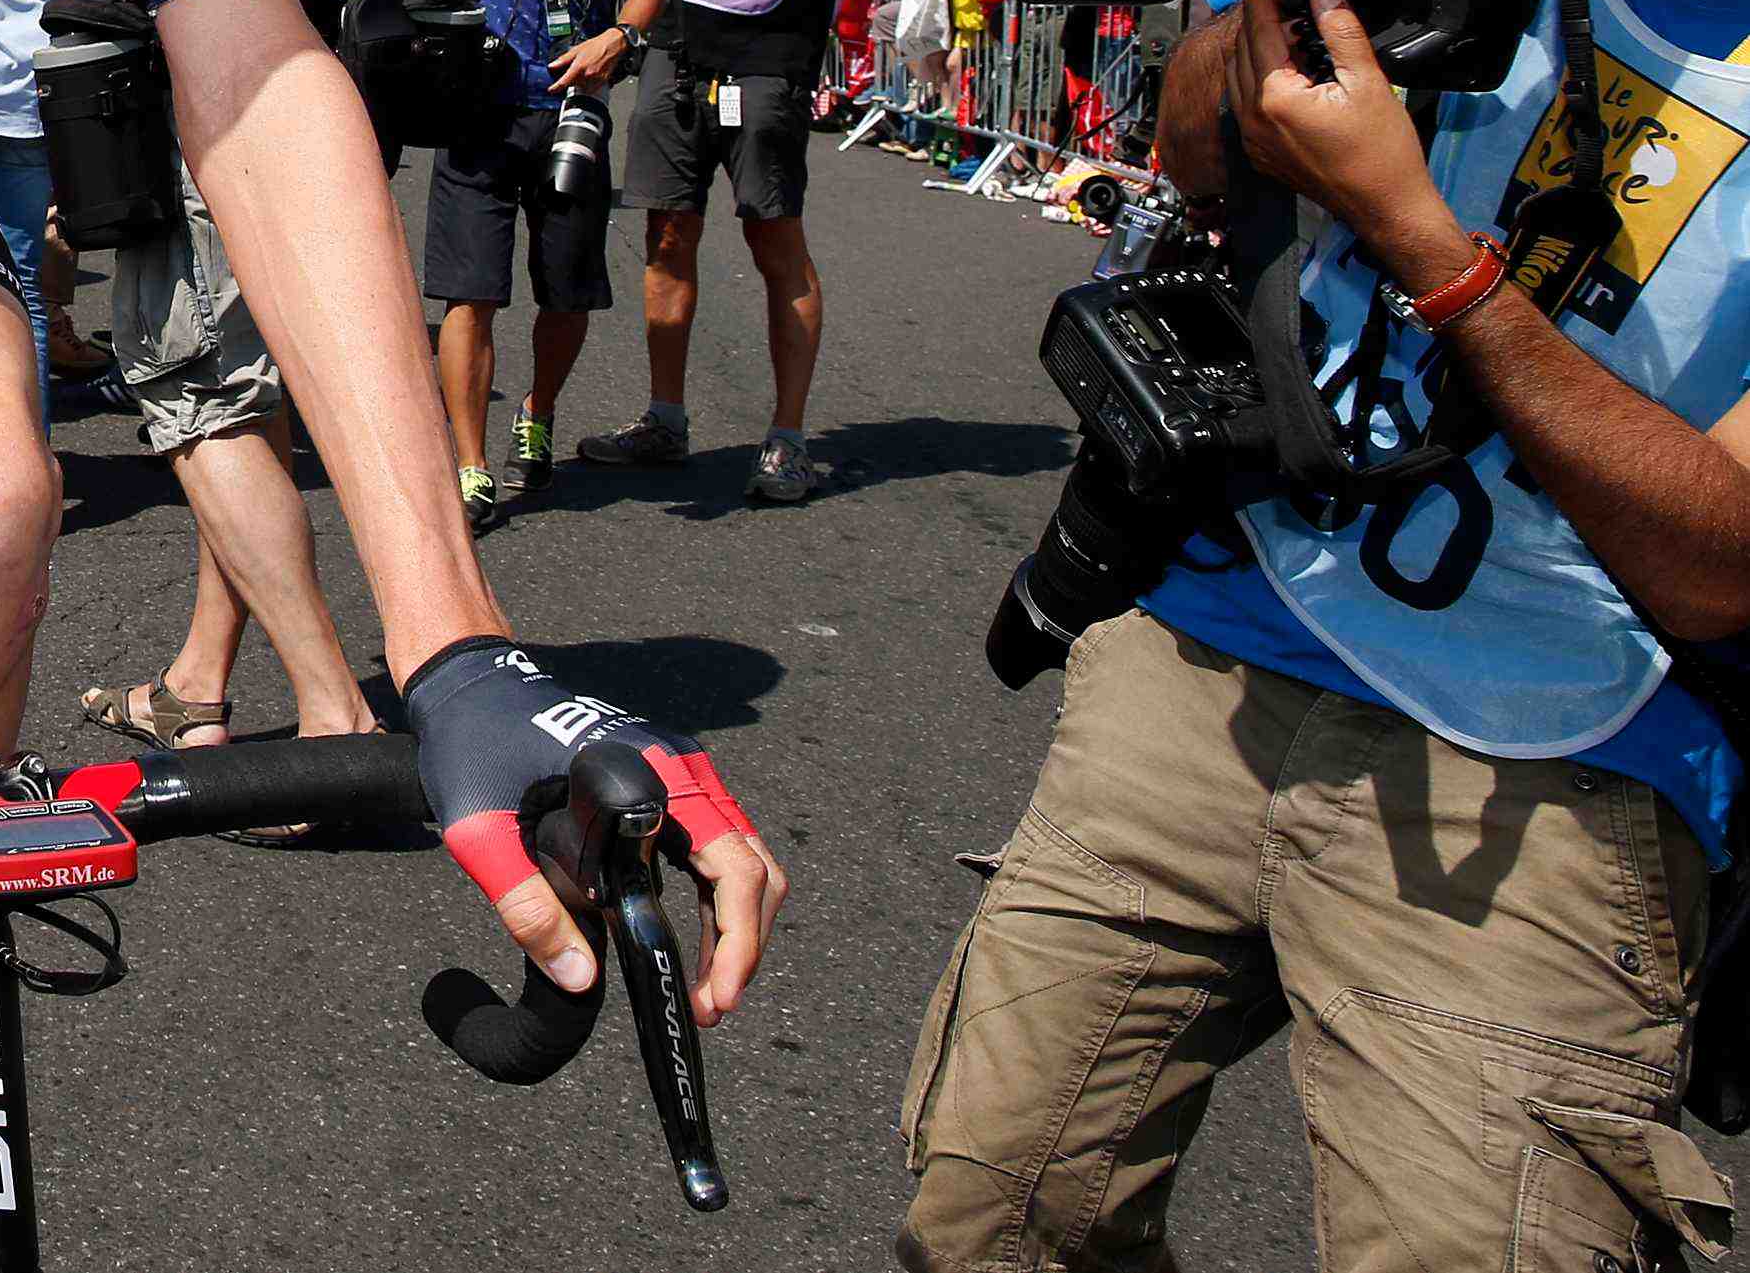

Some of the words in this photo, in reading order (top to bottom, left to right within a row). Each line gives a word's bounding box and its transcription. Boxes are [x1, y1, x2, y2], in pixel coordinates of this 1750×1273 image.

[1513, 234, 1575, 290] Niko
[0, 864, 115, 891] www.SRM.de
[653, 949, 696, 1122] DURA-ACE
